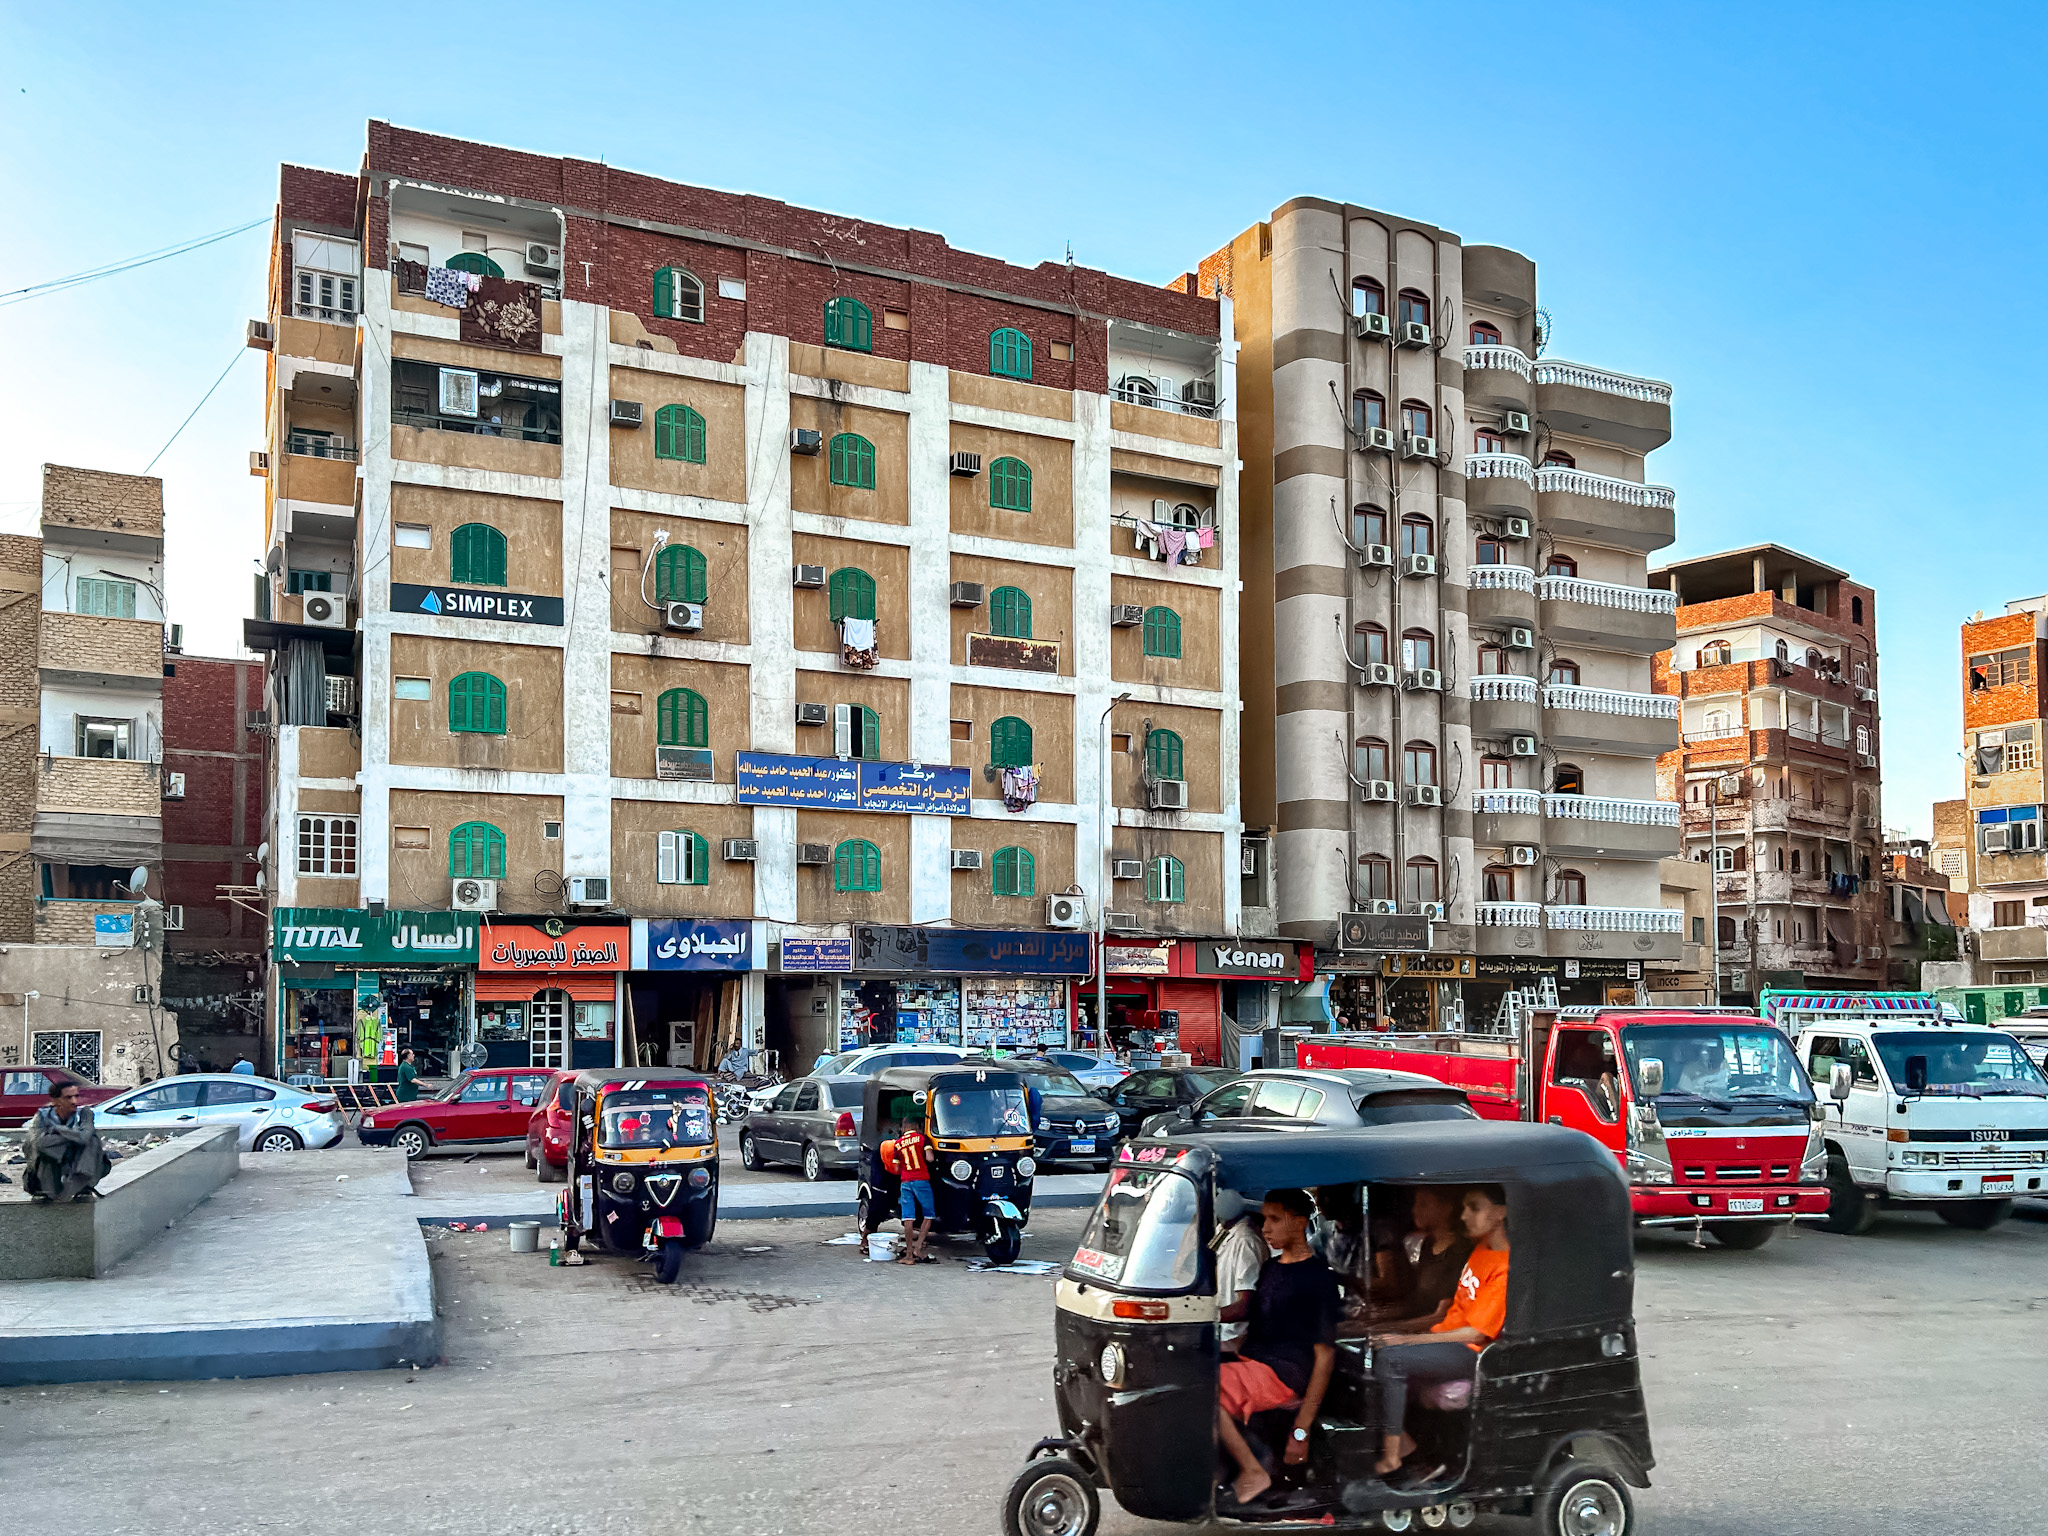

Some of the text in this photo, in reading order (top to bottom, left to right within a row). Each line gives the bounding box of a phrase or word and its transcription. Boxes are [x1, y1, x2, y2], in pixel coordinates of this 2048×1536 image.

[445, 593, 533, 617] SIMPLEX
[898, 767, 935, 781] مركز
[922, 784, 970, 802] الزهراء
[281, 926, 363, 948] TOTAL
[391, 925, 473, 950] العسال
[989, 935, 1084, 963] مركز القدس
[491, 940, 619, 969] الصقر للبصريات
[1215, 944, 1284, 969] Kenan
[901, 1136, 920, 1148] SALAH
[1971, 1130, 2010, 1141] ISUZU
[901, 1145, 921, 1171] 11
